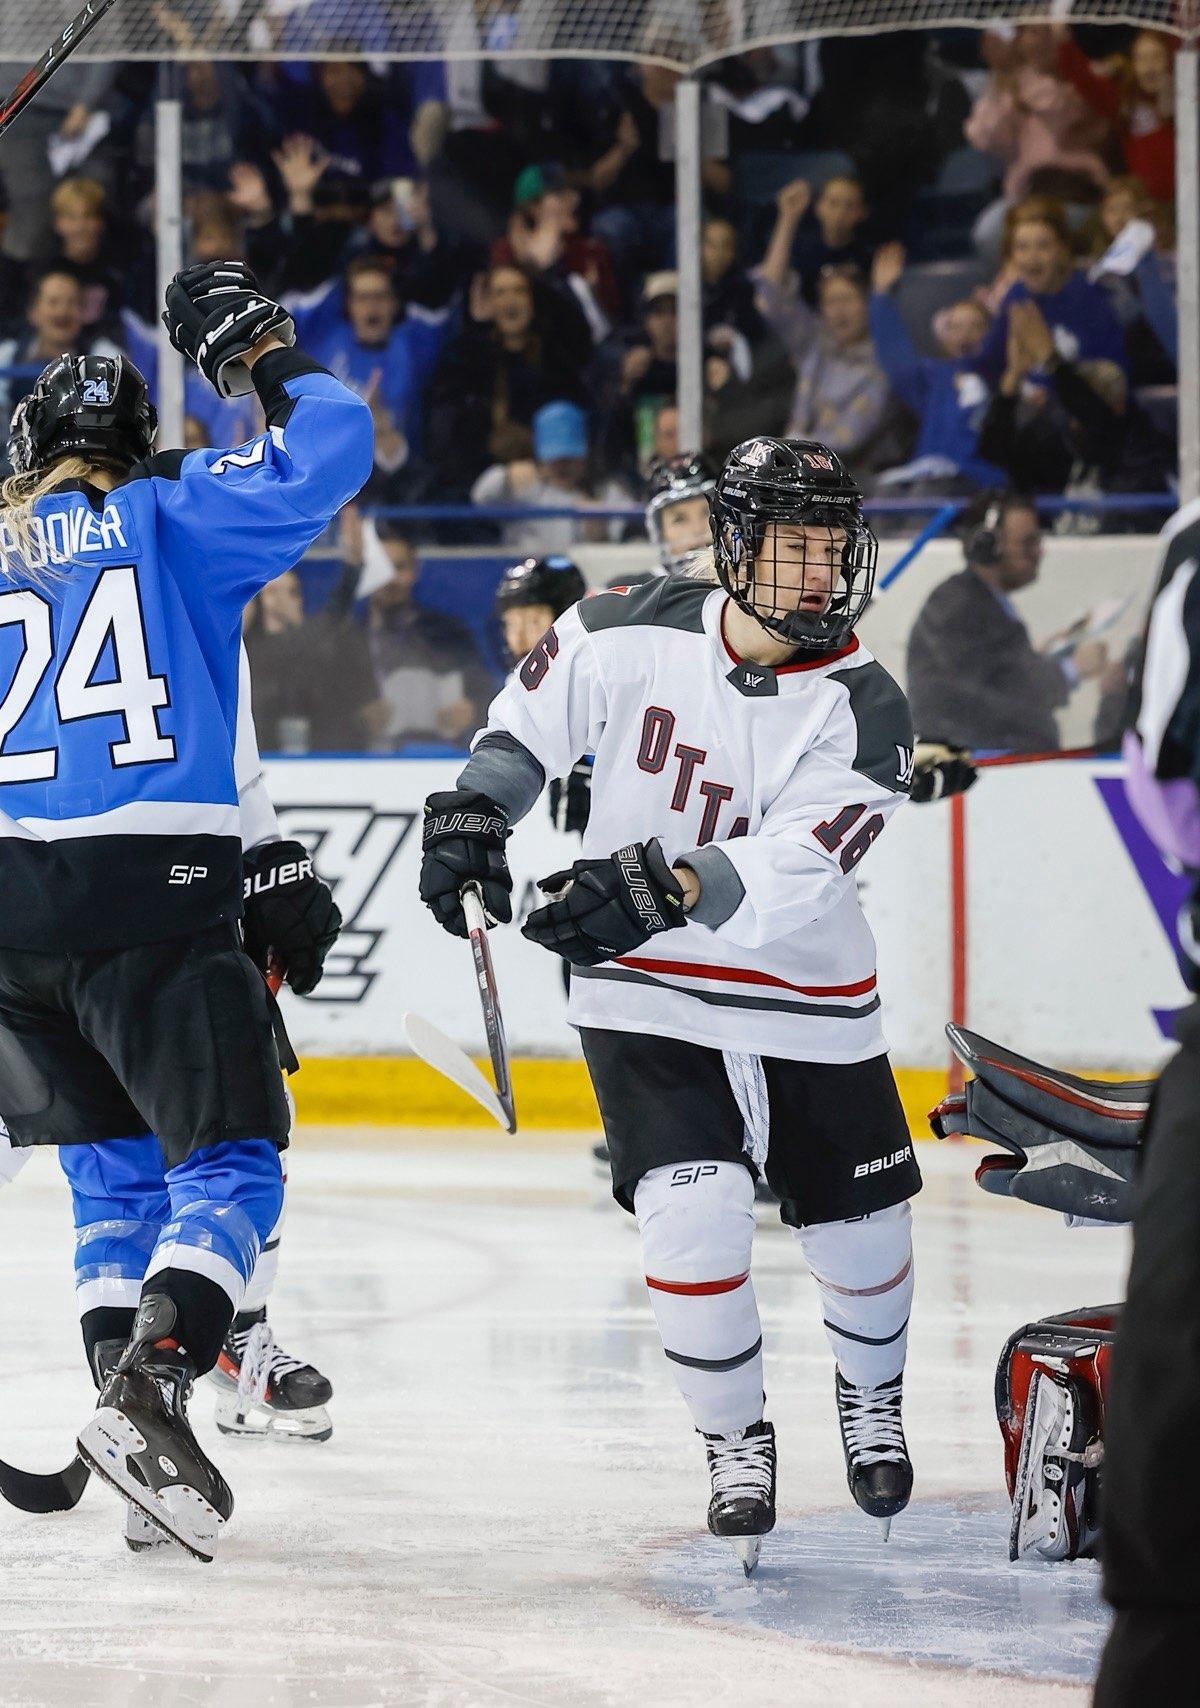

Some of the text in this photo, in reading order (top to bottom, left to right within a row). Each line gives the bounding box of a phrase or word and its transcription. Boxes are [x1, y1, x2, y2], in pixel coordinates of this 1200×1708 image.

[83, 380, 109, 402] 24
[811, 494, 851, 505] BAUER
[423, 813, 505, 841] AUER
[811, 802, 886, 877] 16
[168, 865, 208, 885] SP
[618, 845, 666, 932] AUER
[853, 1146, 912, 1178] BAUER
[670, 1165, 718, 1187] SP
[96, 1425, 120, 1448] TRUE
